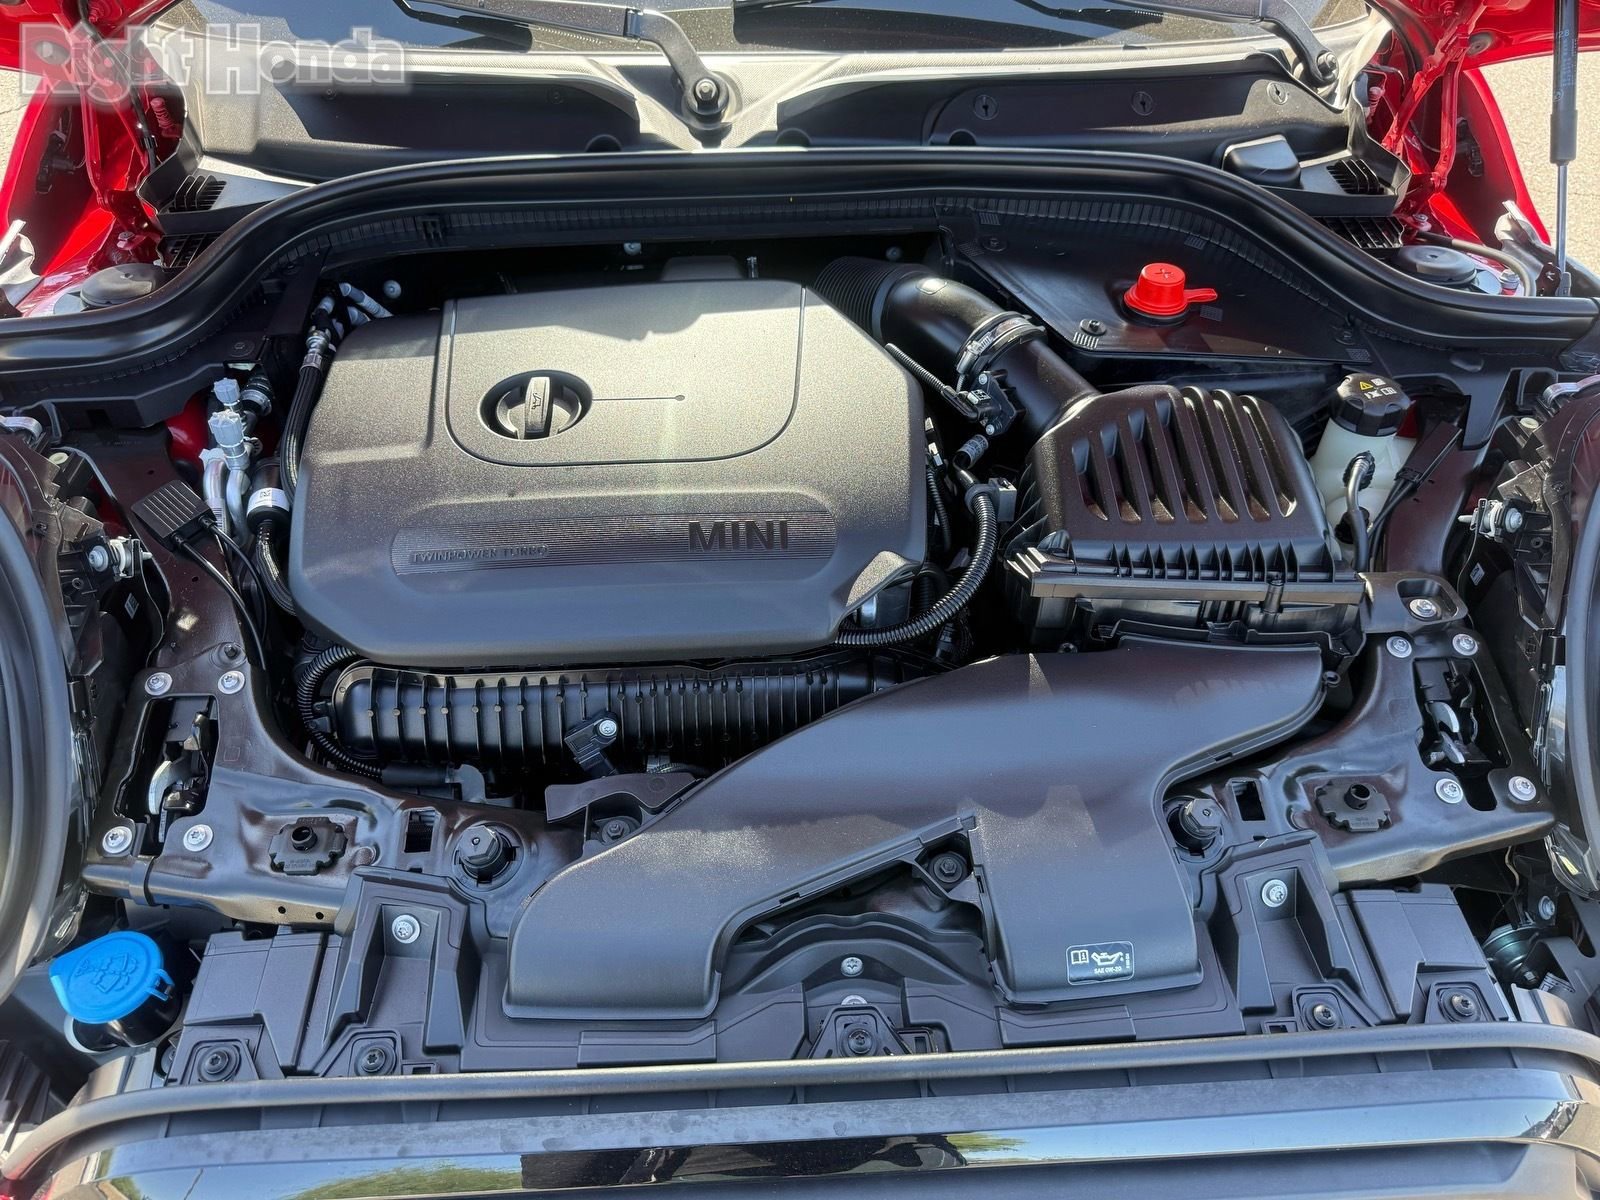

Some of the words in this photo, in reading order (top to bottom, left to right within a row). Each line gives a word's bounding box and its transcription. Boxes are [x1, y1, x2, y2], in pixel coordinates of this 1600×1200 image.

[688, 518, 789, 553] MINI
[414, 549, 498, 562] TWINPOWER
[503, 545, 547, 557] TURBO
